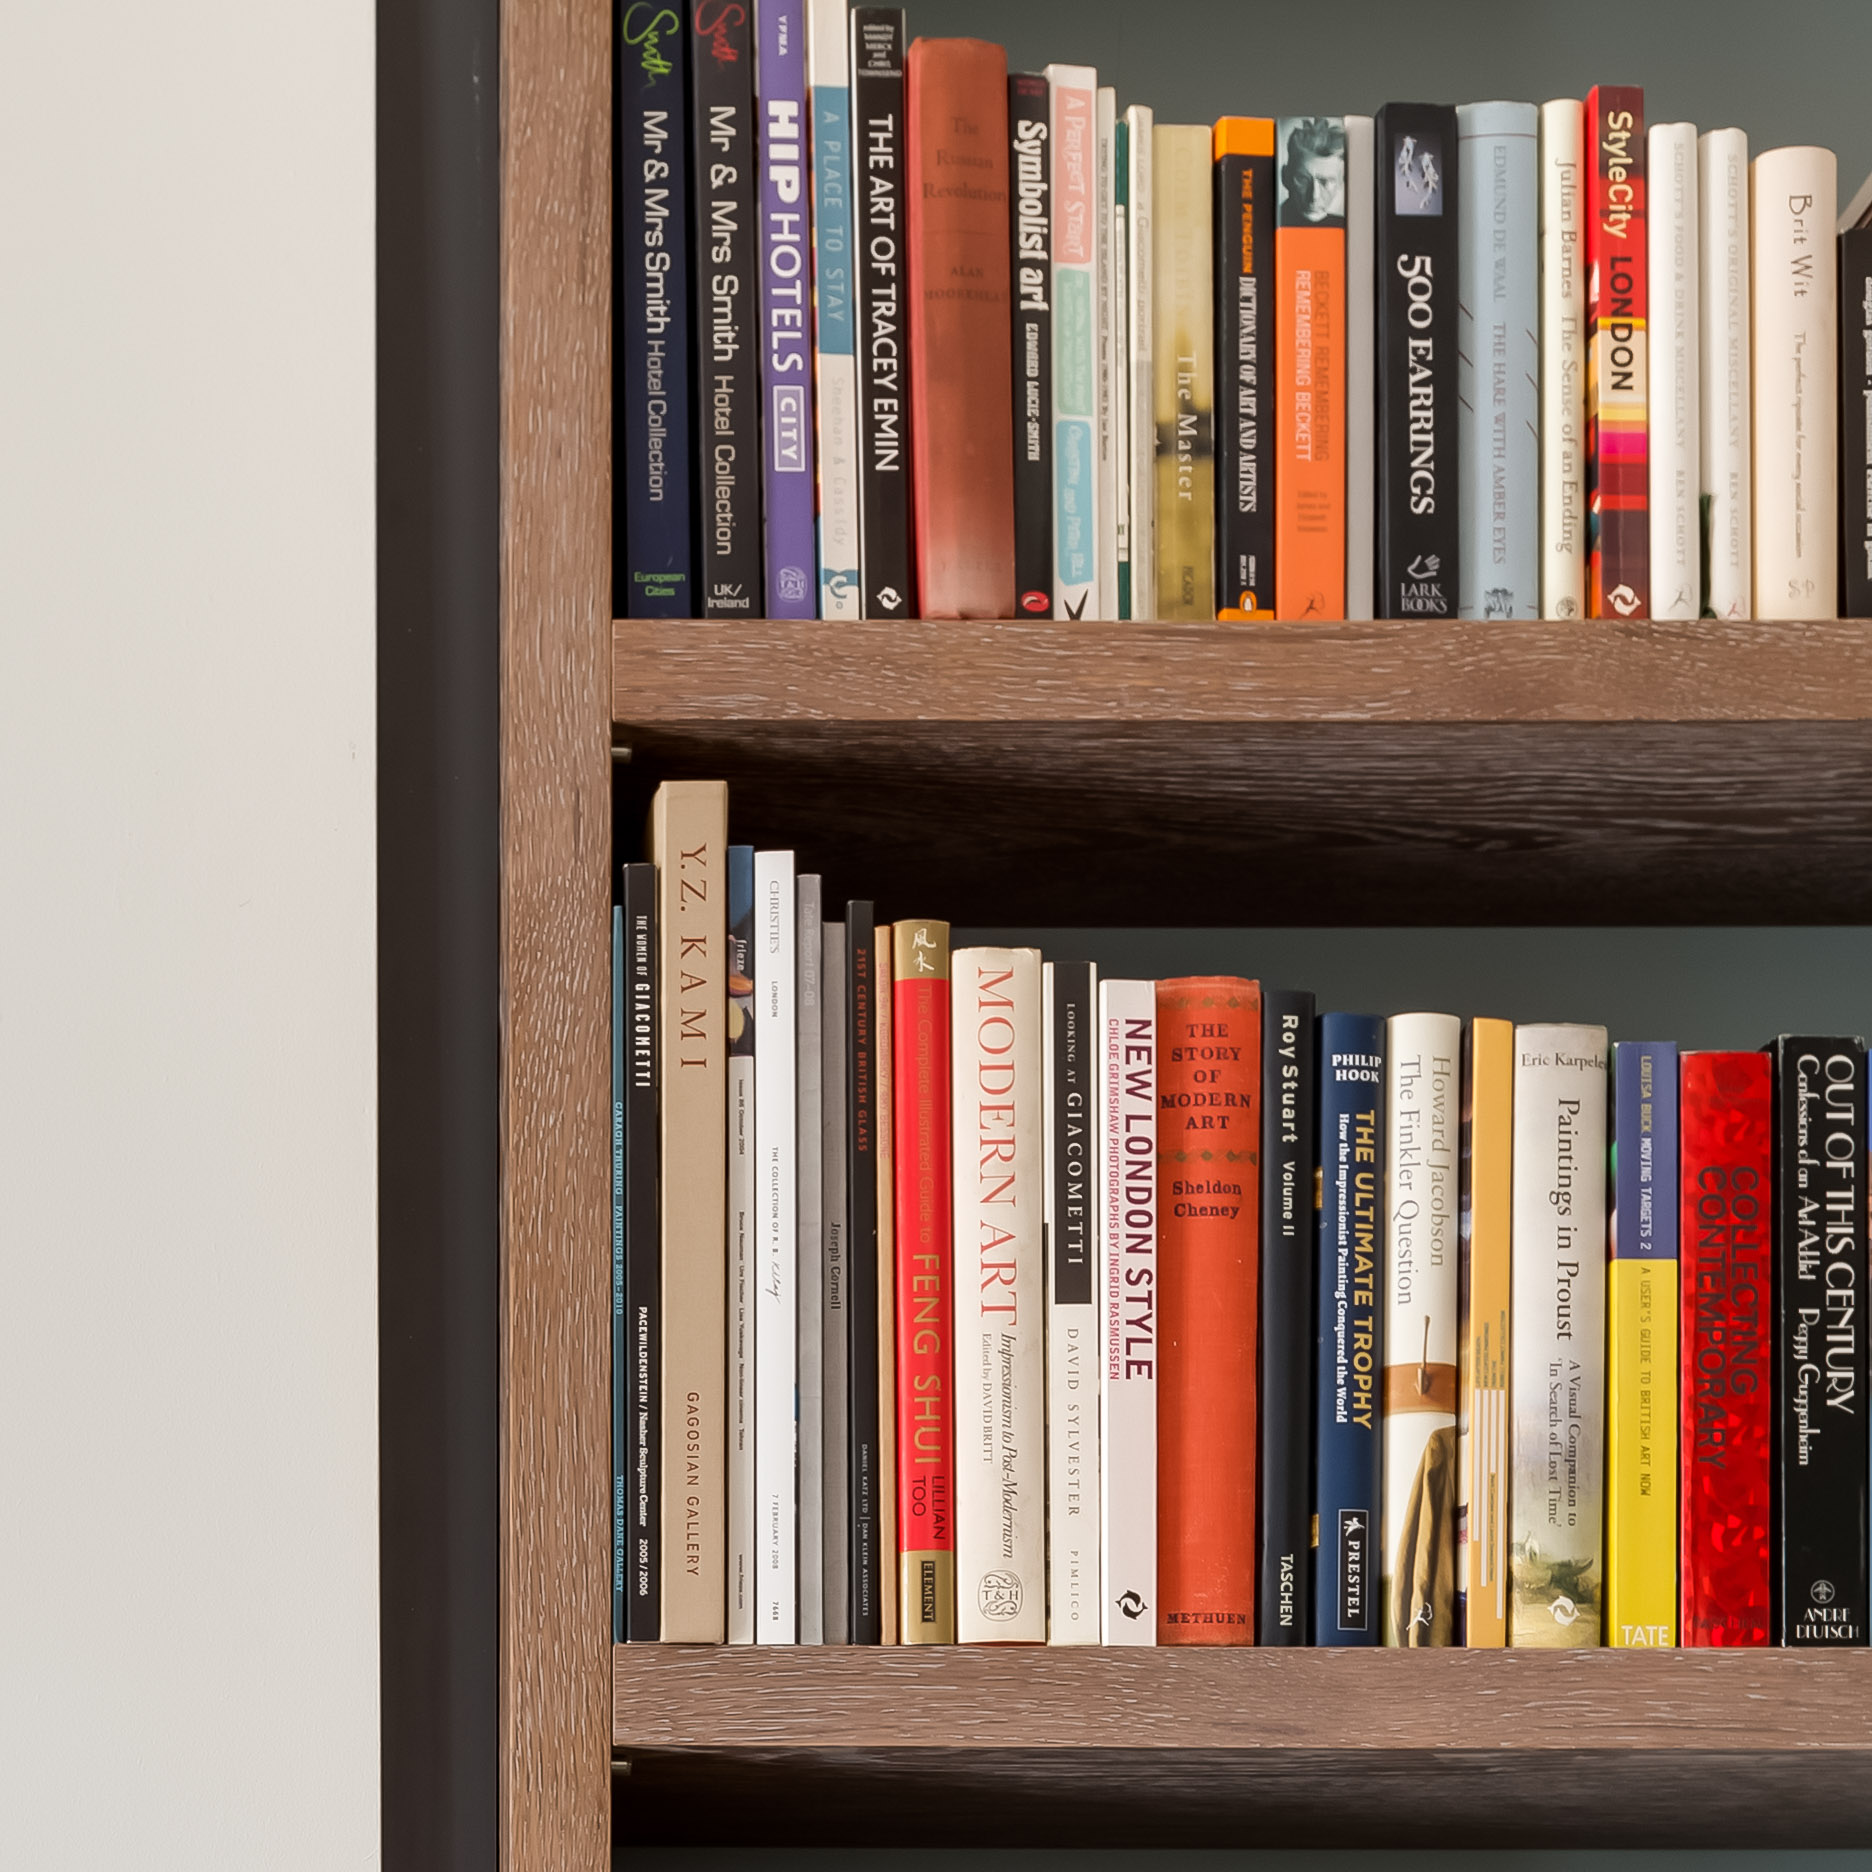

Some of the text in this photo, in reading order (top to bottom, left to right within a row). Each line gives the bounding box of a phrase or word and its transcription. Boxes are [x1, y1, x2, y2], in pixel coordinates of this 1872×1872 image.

[768, 101, 803, 461] HIP HOTELS CITY
[823, 112, 845, 323] A PLACE TO STAY
[868, 115, 899, 471] THE ART OF TRACEY EMIN
[1013, 120, 1048, 260] Symbolist
[1019, 267, 1048, 311] art
[1603, 111, 1634, 391] StyleCity LONDON
[1789, 194, 1813, 298] Brit Wit
[643, 111, 671, 501] Mr & Mrs Smith Hotel Collection
[709, 106, 739, 555] Mr & Mrs Smith Hotel Collection
[1025, 323, 1040, 376] EDWARD
[1239, 169, 1257, 512] THE PENGUIN DICTIONARY OF ART AND ARTISTS
[1295, 270, 1311, 461] REMEMBERING BECKETT
[1396, 254, 1435, 514] 500 EARRINGS
[1177, 353, 1197, 501] The Master
[1400, 583, 1440, 597] LARK
[1401, 599, 1447, 612] BOOKS
[635, 915, 651, 1088] THE WOMEN OF GIACOMETTI
[977, 966, 1020, 1327] MODERN ART
[1125, 1018, 1153, 1381] NEW LONDON STYLE
[1391, 1055, 1422, 1305] The Finkler Question
[1424, 1055, 1452, 1266] Howard Jacobson
[1549, 1098, 1581, 1340] Paintings in Proust
[1824, 1054, 1856, 1414] OUT OF THIS CENTURY
[828, 1222, 842, 1309] Joseph Cornell
[912, 1253, 942, 1464] FENG SHUI
[1066, 1003, 1085, 1517] LOOKING AT GIACOMETTI DAVID SYLVESTER
[1277, 1015, 1300, 1626] Roy Stuart Volume II TASCHEN
[1351, 1110, 1375, 1429] THE ULTIMATE TROPHY
[1697, 1166, 1727, 1469] CONTEMPORARY
[1729, 1166, 1759, 1394] COLLECTING
[685, 1392, 700, 1489] GAGOSIAN
[912, 1475, 926, 1517] TOO
[979, 1333, 993, 1464] Edited by DAVID BRITT
[686, 1496, 700, 1577] GALLERY
[921, 1561, 936, 1623] ELEMENT
[931, 1475, 946, 1540] LILLIAN
[1346, 1540, 1360, 1619] PRESTEL
